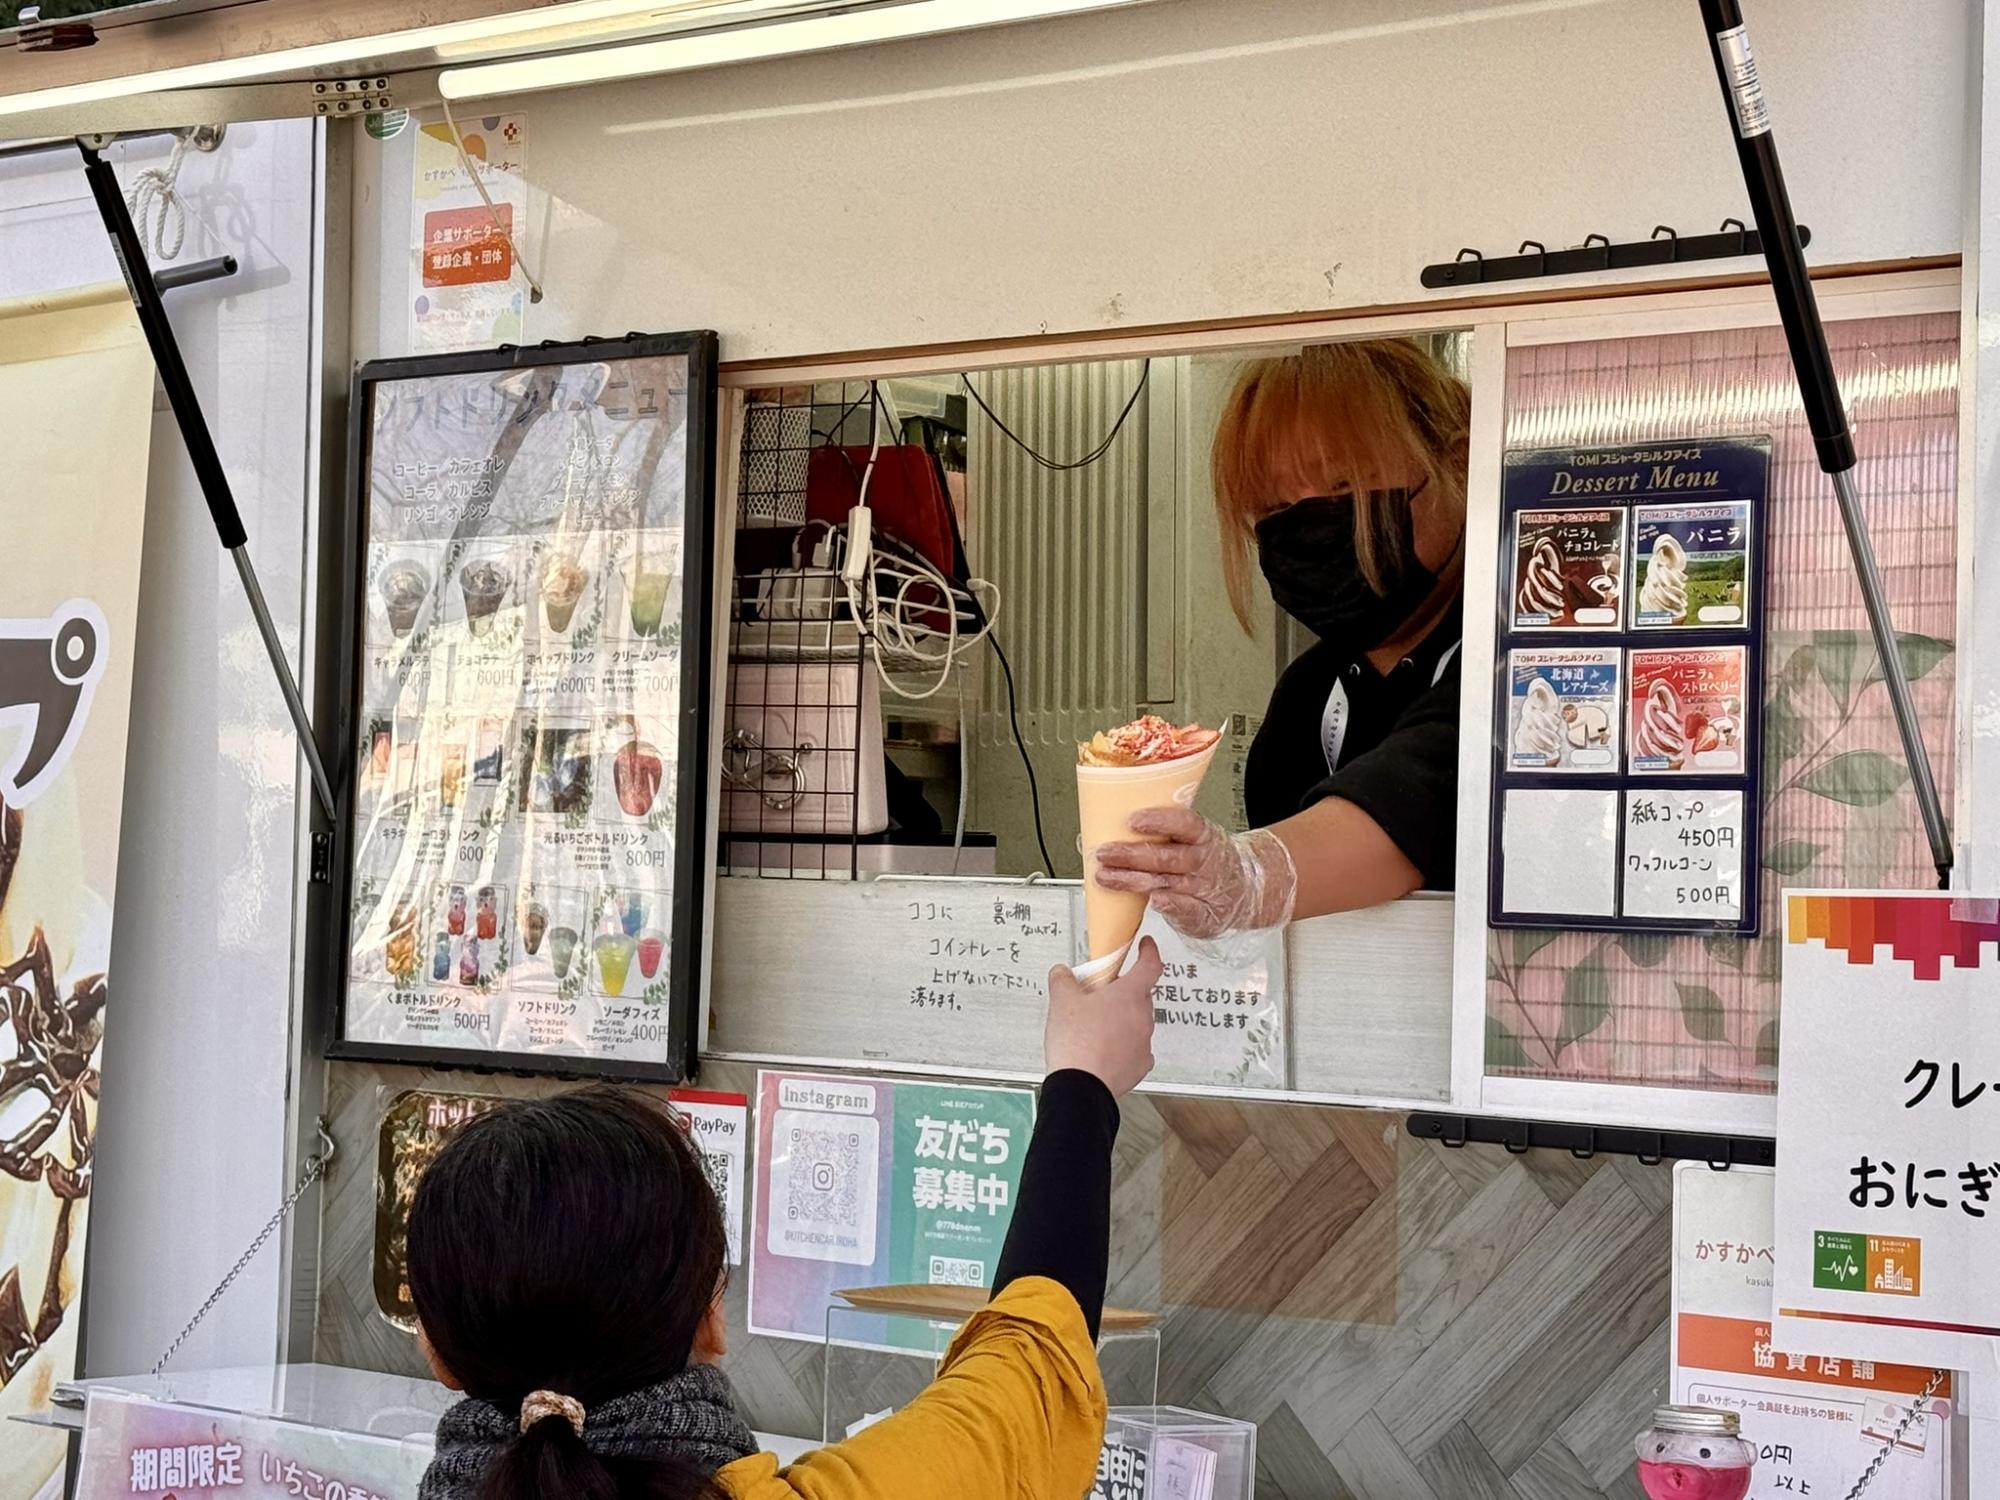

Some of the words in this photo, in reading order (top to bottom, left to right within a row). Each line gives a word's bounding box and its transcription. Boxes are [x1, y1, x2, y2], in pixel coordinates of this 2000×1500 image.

[432, 224, 503, 244] 企業サポーター
[431, 248, 503, 270] 登録企業・団体
[395, 462, 438, 477] コーヒー
[448, 457, 504, 475] カフェオレ
[1569, 455, 1600, 467] TOMI
[405, 483, 436, 499] コーラ
[448, 480, 491, 498] カルピス
[1549, 471, 1640, 495] Dessert
[1645, 465, 1719, 490] Menu
[405, 506, 436, 523] リンゴ
[447, 503, 491, 521] オレンジ
[1686, 527, 1741, 545] バニラ
[1564, 540, 1619, 553] チョコレート
[612, 650, 679, 663] クリームソーダ
[1551, 667, 1584, 681] 北海道
[560, 676, 596, 693] 600円
[1561, 680, 1609, 693] レアチーズ
[1680, 680, 1739, 695] ストロベリー
[543, 831, 649, 845] 光るいちごボトルドリンク
[1677, 827, 1735, 848] 450円
[626, 849, 666, 867] 800円
[1628, 855, 1713, 872] ワッフルコーン
[1676, 886, 1731, 904] 500円
[908, 902, 953, 920] ココに
[929, 937, 1021, 963] コイントレーを
[387, 992, 461, 1008] くまボトルドリンク
[1152, 985, 1262, 1007] 不足しております
[517, 1000, 577, 1016] ソフトドリンク
[602, 1005, 662, 1021] ソーダフィズ
[454, 1012, 490, 1031] 500円
[1154, 1008, 1249, 1030] 願いいたします
[631, 1023, 668, 1042] 400円
[1904, 1059, 2000, 1109] クレ
[784, 1085, 868, 1110] Instagram
[694, 1116, 737, 1136] PayPay
[915, 1115, 1010, 1164] 友だち
[912, 1166, 1009, 1216] 募集中
[1848, 1156, 2000, 1218] おにぎ
[1818, 1235, 1825, 1248] 3
[1869, 1239, 1879, 1252] 11
[1695, 1239, 1774, 1264] かすかべ
[130, 1441, 244, 1492] 期間限定
[260, 1452, 389, 1500] いちごの
[1774, 1474, 1812, 1496] 以上
